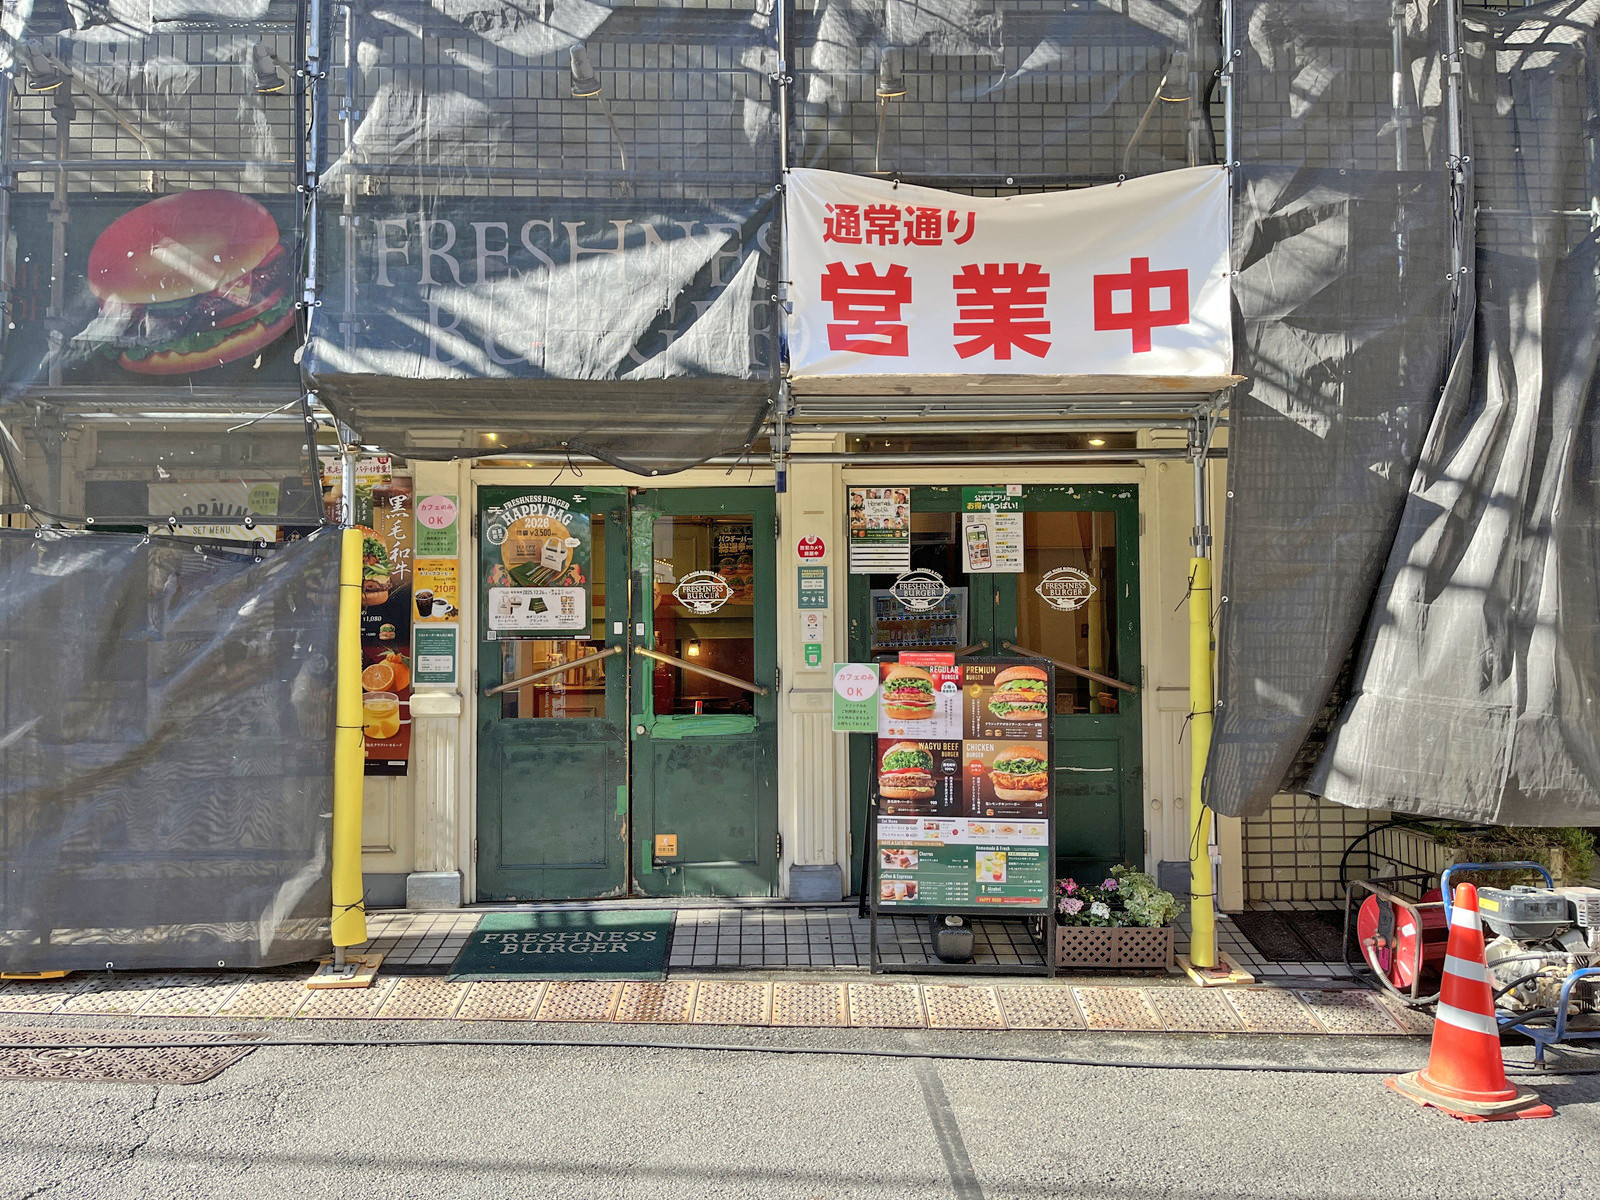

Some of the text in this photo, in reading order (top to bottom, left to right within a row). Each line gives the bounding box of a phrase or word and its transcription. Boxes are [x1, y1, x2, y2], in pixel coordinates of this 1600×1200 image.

[822, 203, 976, 246] 通常通り
[820, 256, 1190, 360] 営業中
[503, 495, 570, 510] FRESHNESS BURGER
[974, 494, 1011, 502] 公式アプリは
[966, 502, 1018, 510] お得がいっぱい!
[501, 503, 574, 526] HAPPY BAG
[428, 516, 443, 525] OK
[525, 517, 550, 528] 2026
[192, 525, 231, 535] SET MENU
[385, 494, 411, 580] 黒毛和牛
[434, 585, 456, 593] 210円
[682, 585, 724, 593] FRESHNESS
[904, 589, 936, 597] BURGER
[929, 666, 959, 674] REGULAR
[966, 665, 996, 674] PREMIUM
[839, 673, 874, 681] カフェのみ
[847, 687, 863, 697] OK
[919, 742, 959, 750] WAGYU BEEF
[966, 743, 994, 751] CHICKEN
[480, 931, 657, 944] FRESHNESS
[500, 942, 629, 955] BURGER
